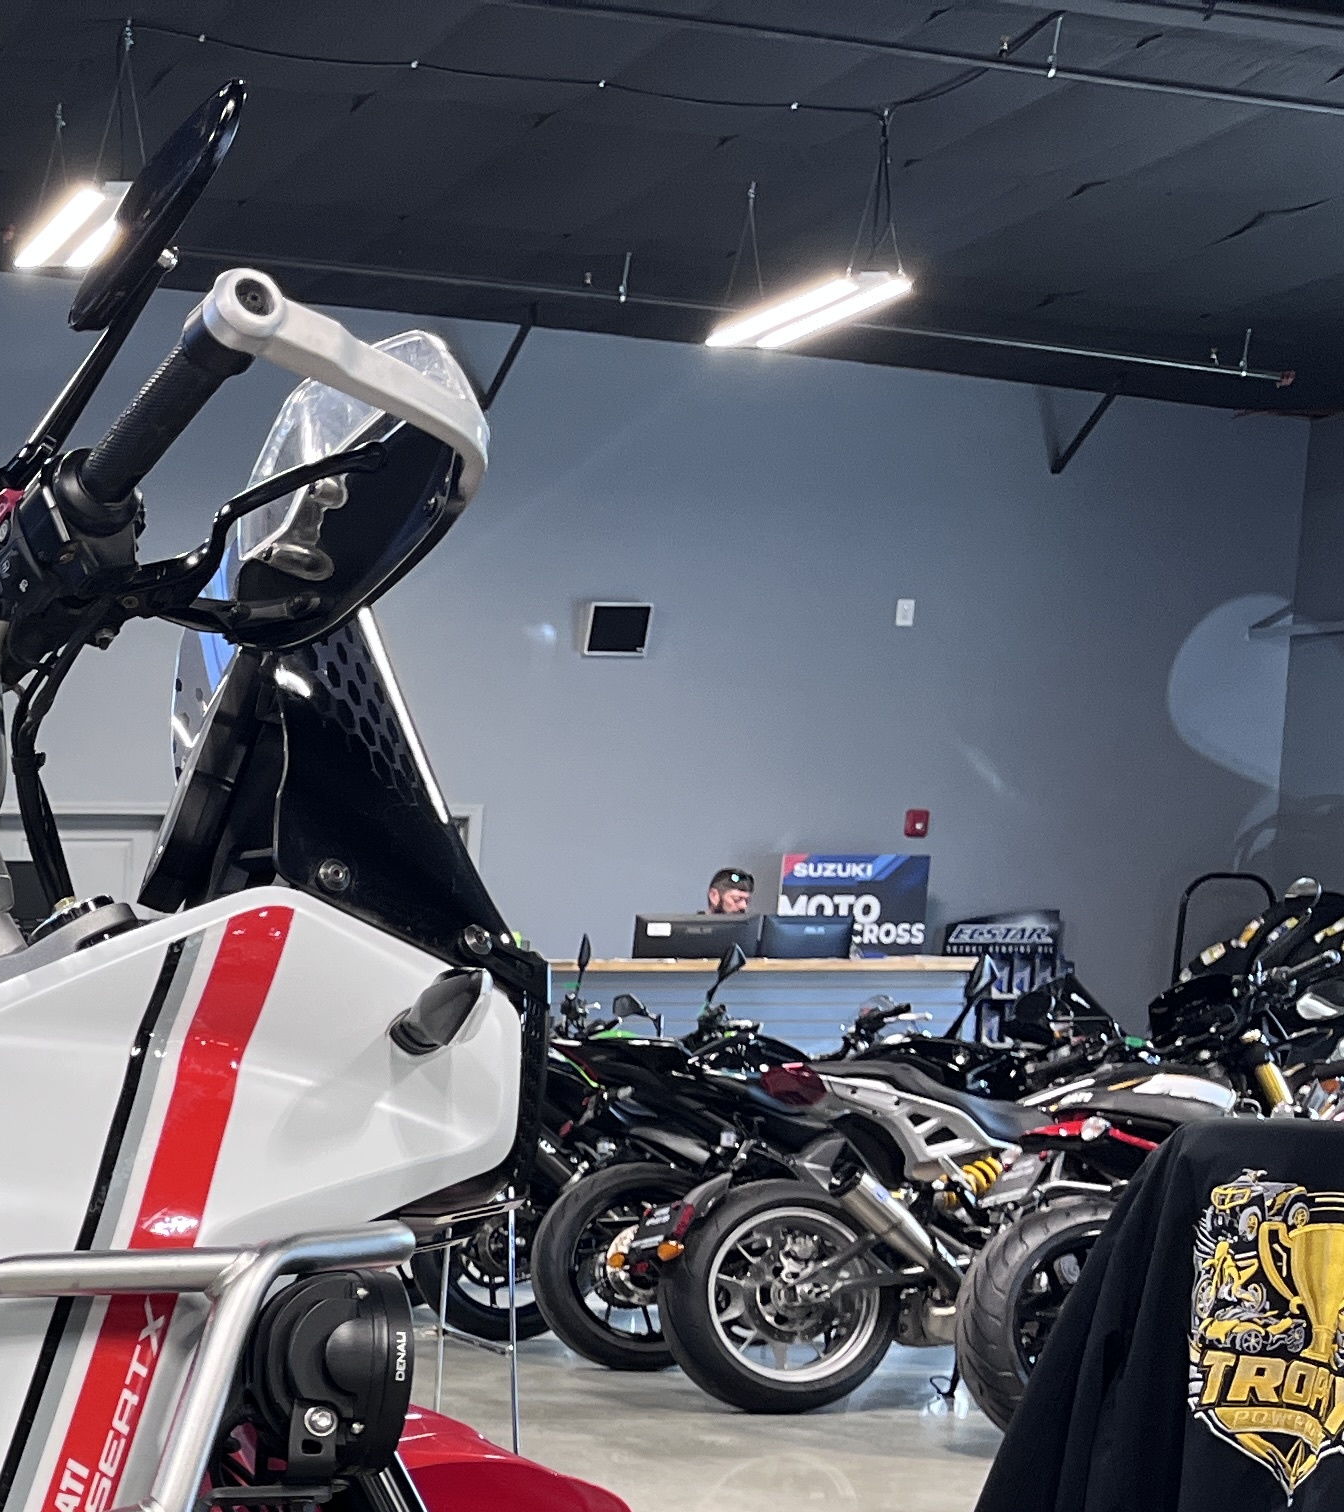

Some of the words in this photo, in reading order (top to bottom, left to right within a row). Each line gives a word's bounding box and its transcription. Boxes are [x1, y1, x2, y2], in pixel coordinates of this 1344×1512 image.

[793, 862, 874, 878] SUZUKI
[777, 893, 882, 924] MOTO
[395, 1331, 407, 1381] DENALI
